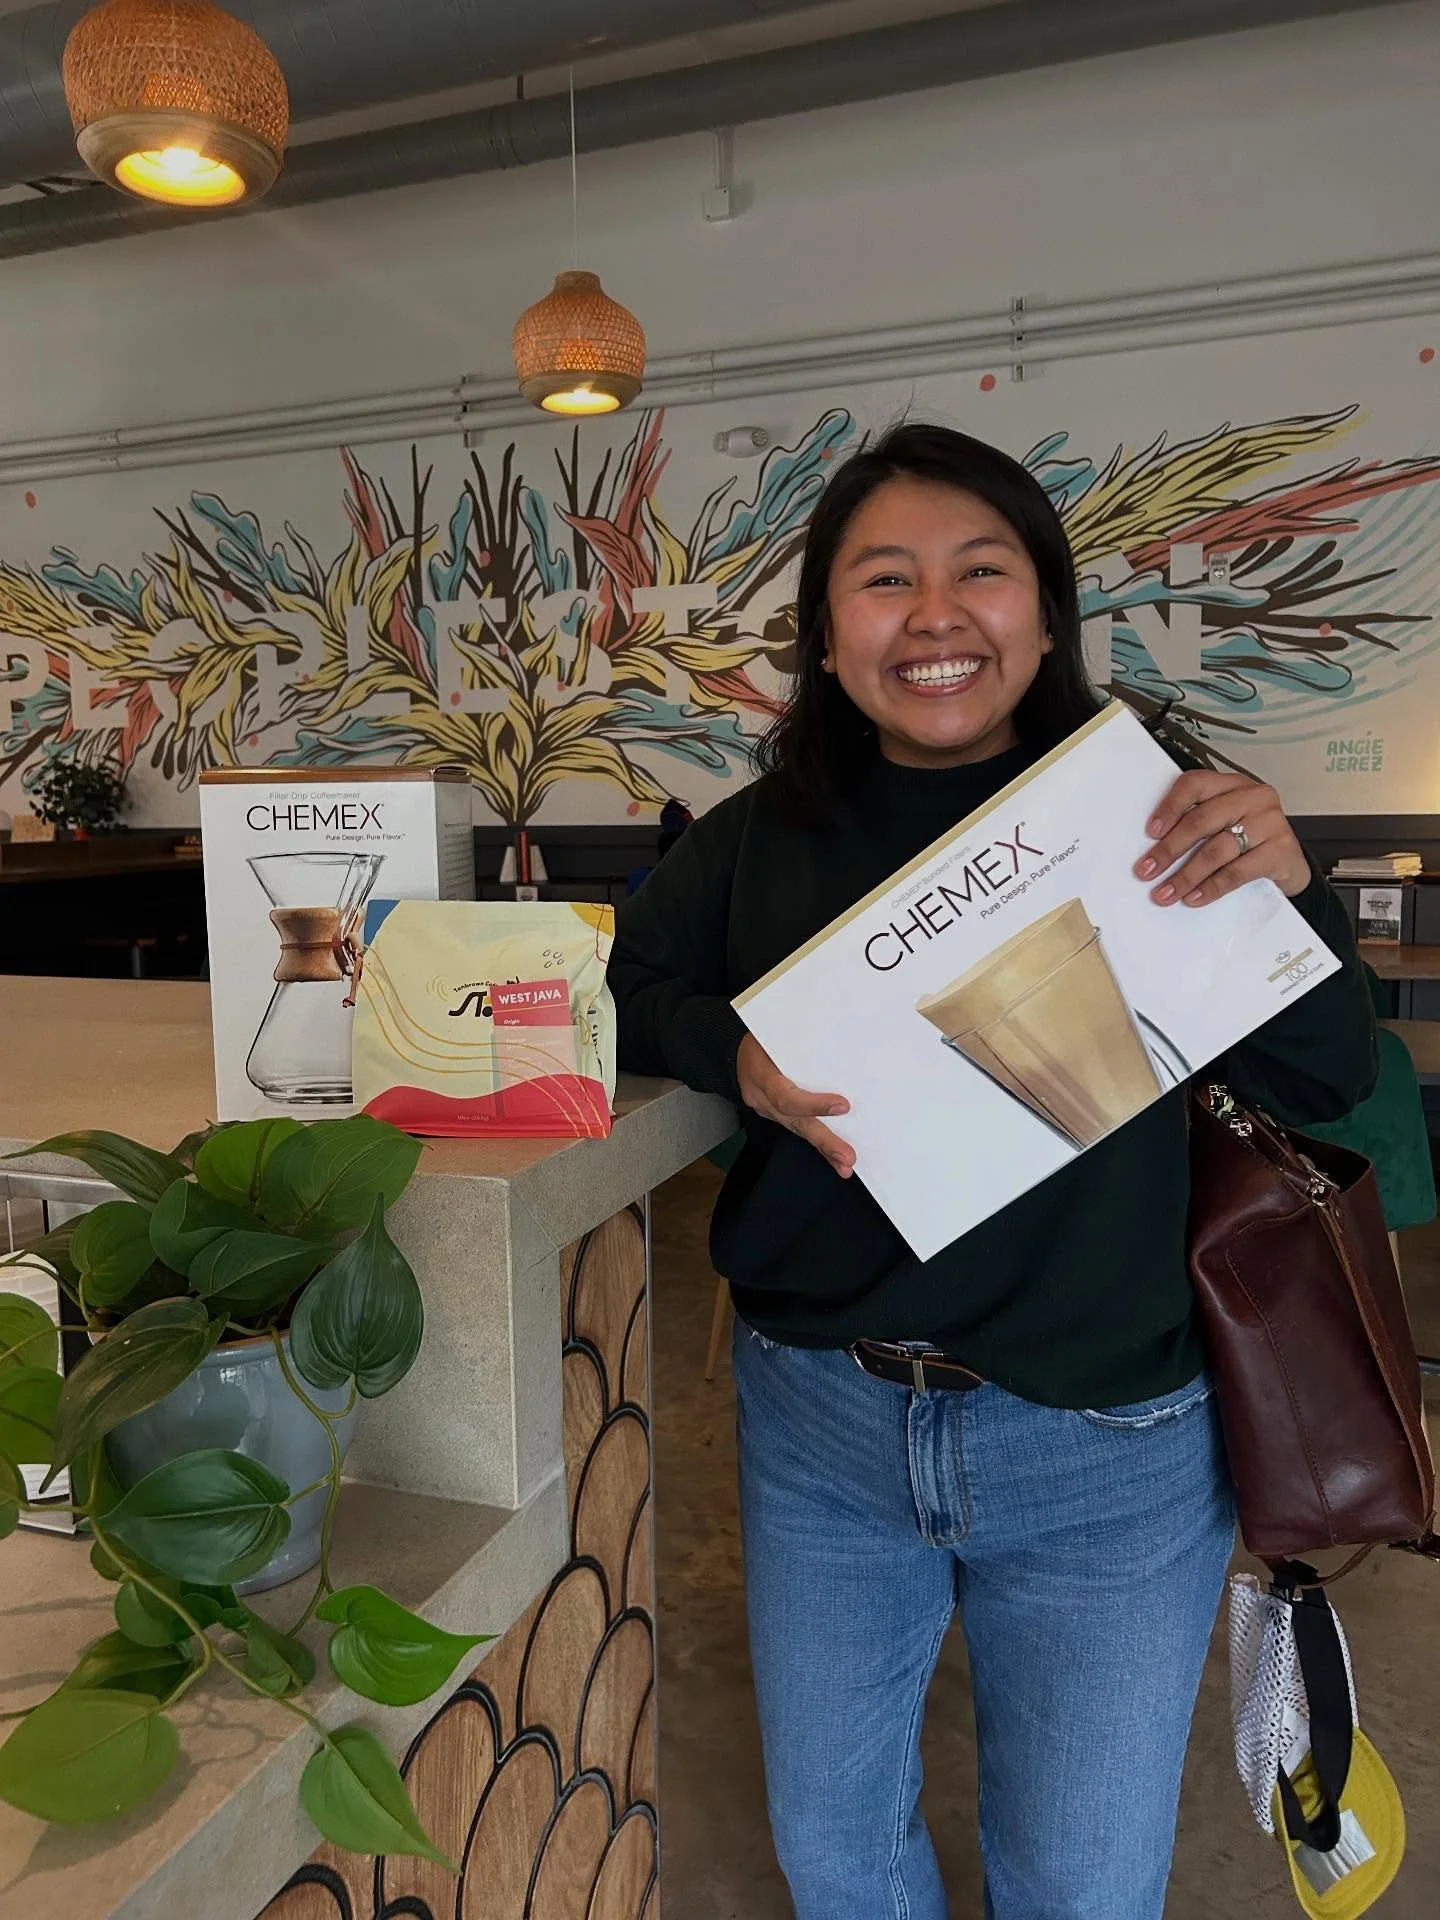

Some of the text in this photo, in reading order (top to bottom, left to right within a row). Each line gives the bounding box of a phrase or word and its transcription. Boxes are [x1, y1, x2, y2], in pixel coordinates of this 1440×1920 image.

[1327, 738, 1384, 756] ANGIE
[1325, 756, 1383, 772] JEREZ
[269, 791, 360, 801] Filter Drip Coffeemaker
[247, 803, 383, 830] CHEMEX
[865, 824, 1044, 971] CHEMEX
[980, 903, 1001, 919] Pure
[1000, 880, 1032, 905] Design.
[1031, 865, 1051, 883] Pure
[1285, 962, 1308, 982] 100
[498, 993, 531, 1005] WEST
[533, 988, 562, 1005] JAVA
